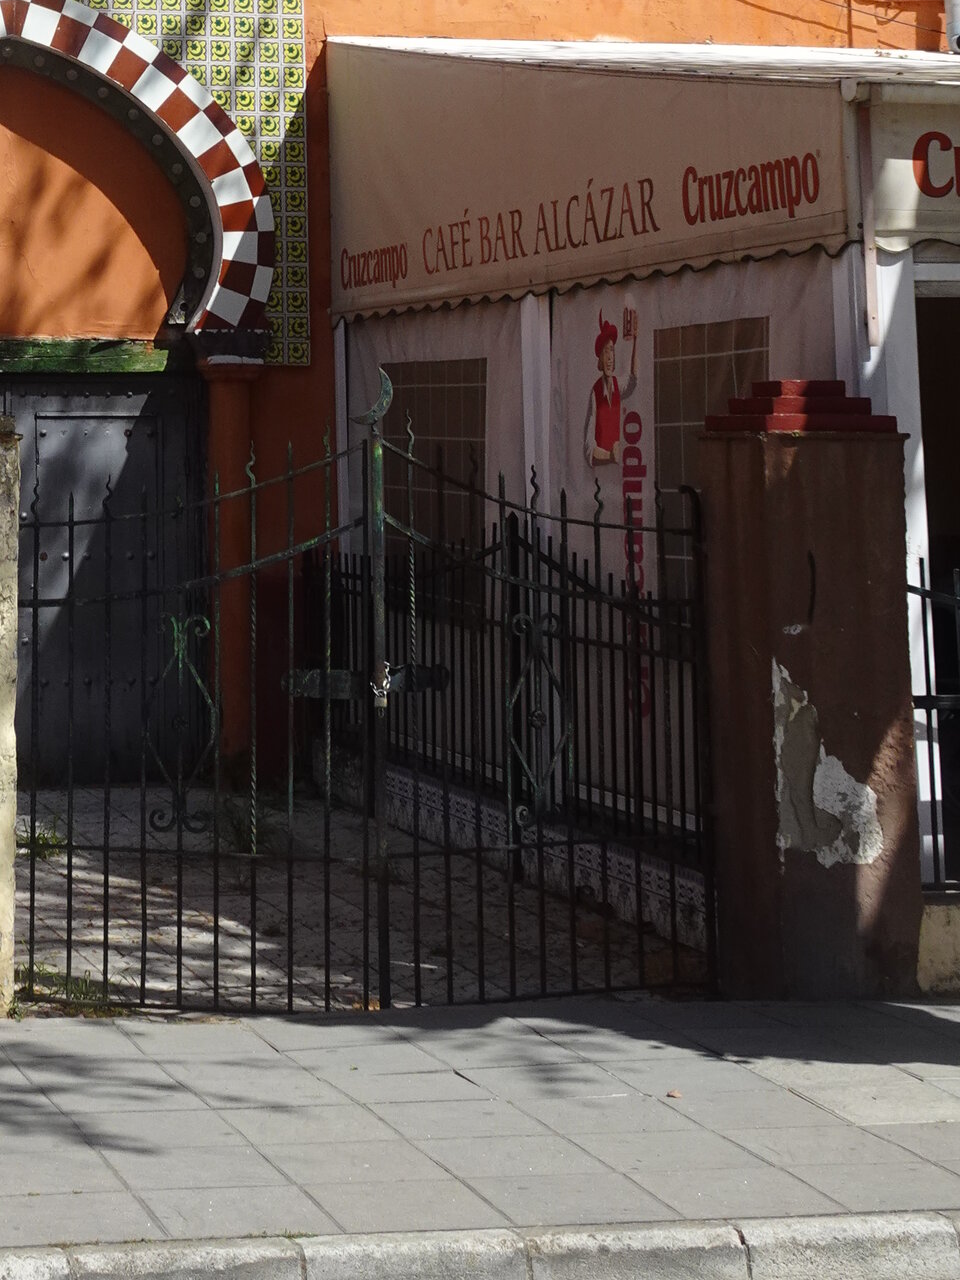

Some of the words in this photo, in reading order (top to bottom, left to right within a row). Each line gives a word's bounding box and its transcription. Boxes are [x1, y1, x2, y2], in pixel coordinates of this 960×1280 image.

[912, 131, 960, 198] C
[341, 245, 408, 290] Cruzcampo
[422, 208, 473, 275] CAFÉ
[478, 209, 528, 265] BAR
[533, 177, 661, 256] ALCÁZAR
[681, 152, 820, 226] Cruzcampo
